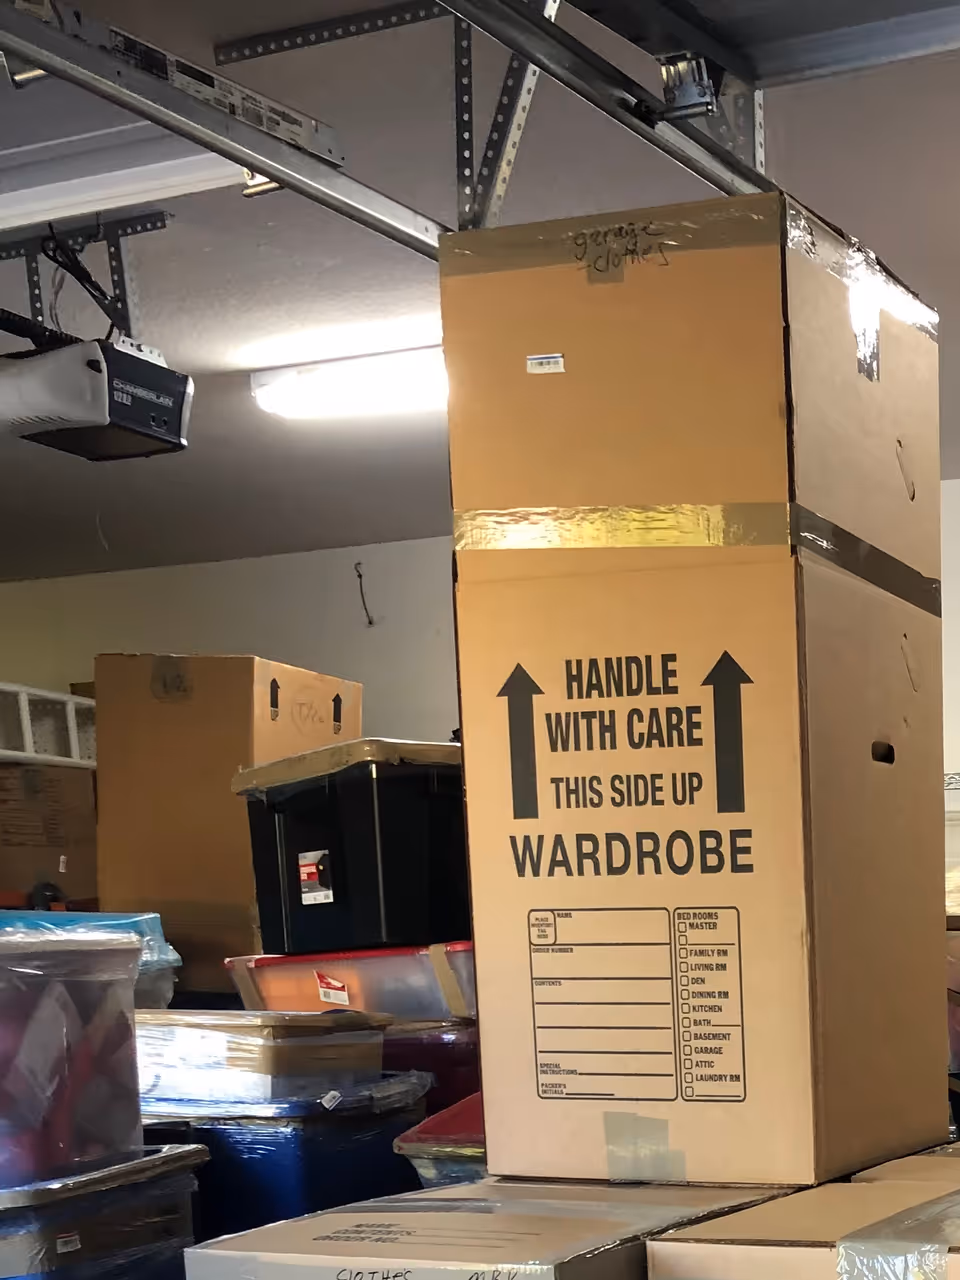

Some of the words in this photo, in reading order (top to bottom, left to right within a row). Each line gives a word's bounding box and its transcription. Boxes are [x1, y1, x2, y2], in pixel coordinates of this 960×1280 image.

[113, 380, 174, 406] CHAMBERLAIN
[565, 653, 678, 700] HANDLE
[546, 710, 617, 752] WITH
[627, 706, 703, 749] CARE
[551, 776, 603, 809] THIS
[610, 774, 664, 807] SIDE
[672, 772, 702, 806] UP
[510, 829, 754, 878] WARDROBE
[677, 912, 692, 920] BED
[693, 912, 718, 920] ROOMS
[689, 922, 717, 930] MASTER
[690, 949, 715, 957] FAMILY
[717, 949, 728, 957] RM
[690, 963, 714, 972] LIVING
[691, 977, 705, 985] DEN
[691, 991, 716, 999] DINING
[718, 991, 729, 999] RM
[694, 1033, 731, 1041] BASEMENT
[694, 1047, 723, 1055] GARAGE
[696, 1074, 727, 1082] LAUNDRY
